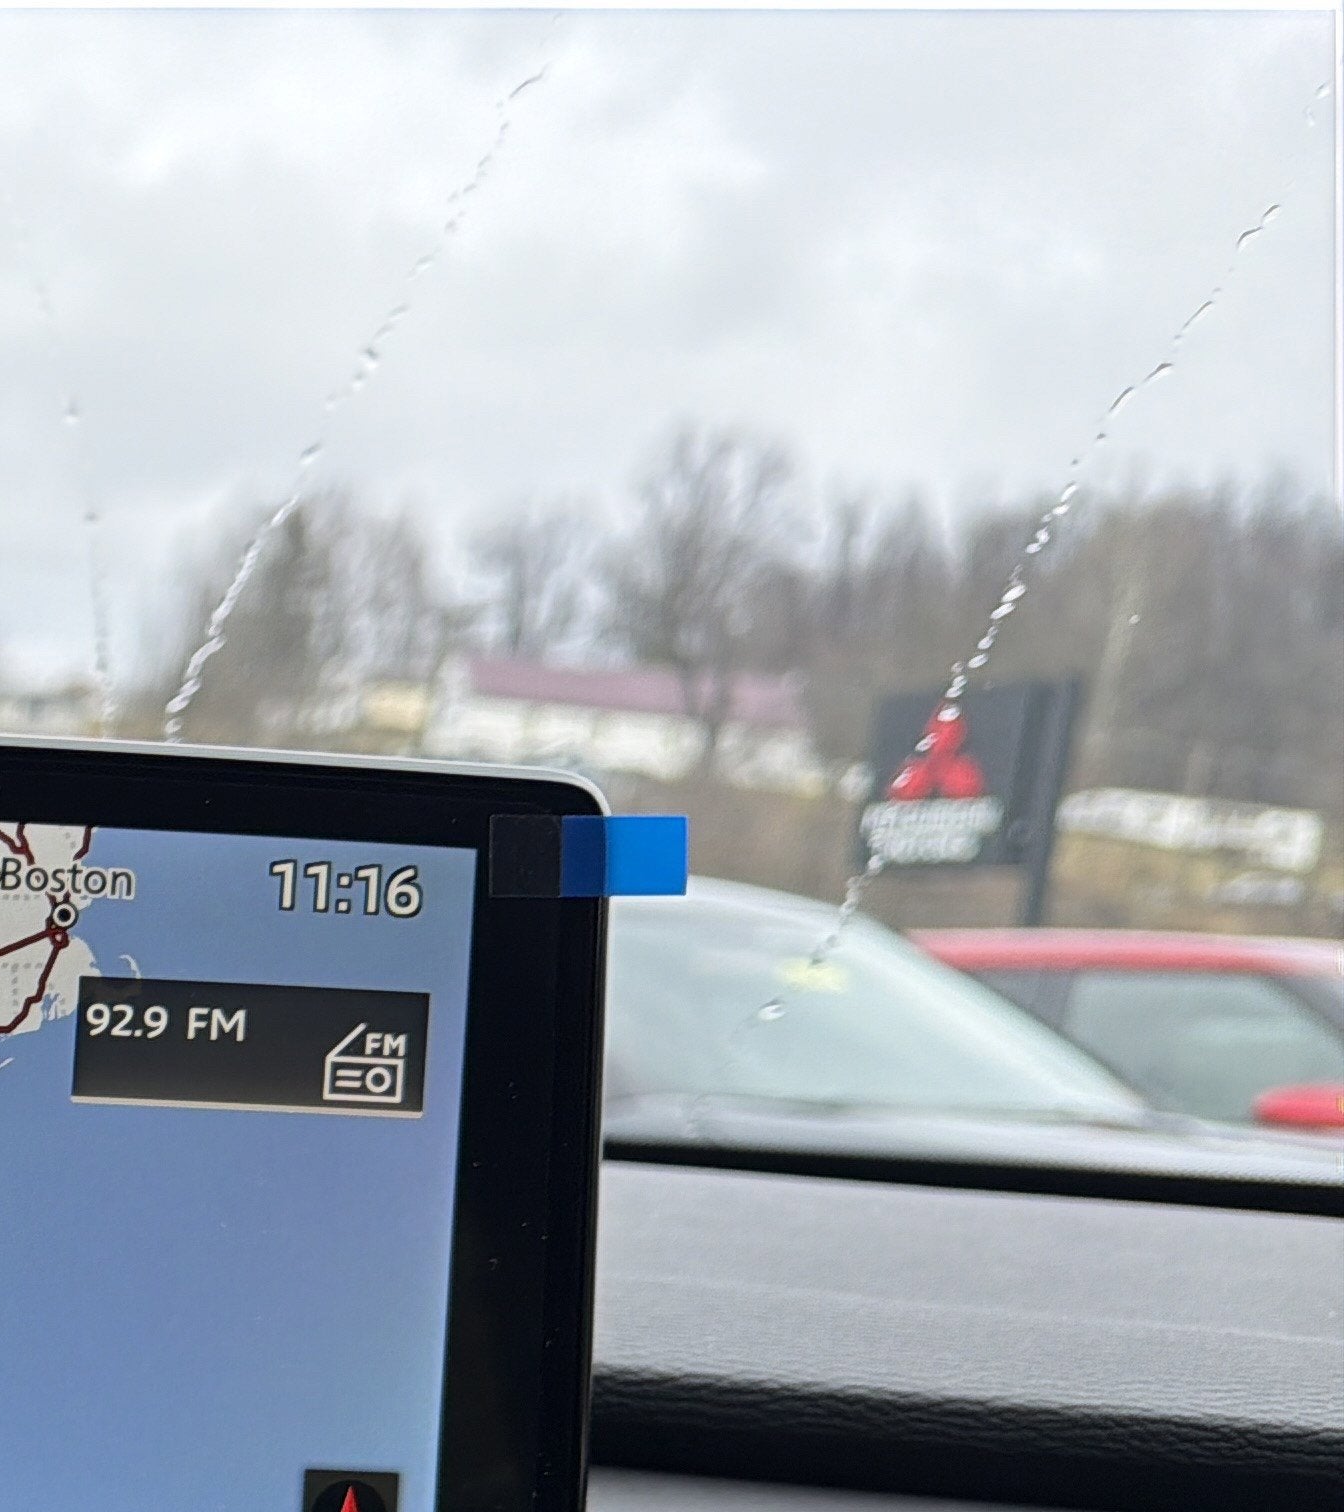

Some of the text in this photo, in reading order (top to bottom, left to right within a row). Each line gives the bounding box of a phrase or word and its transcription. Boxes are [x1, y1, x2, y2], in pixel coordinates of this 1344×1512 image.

[0, 858, 134, 897] Boston
[269, 858, 425, 917] 11:16
[85, 1003, 246, 1041] 92.9 FM
[365, 1033, 407, 1057] FM
